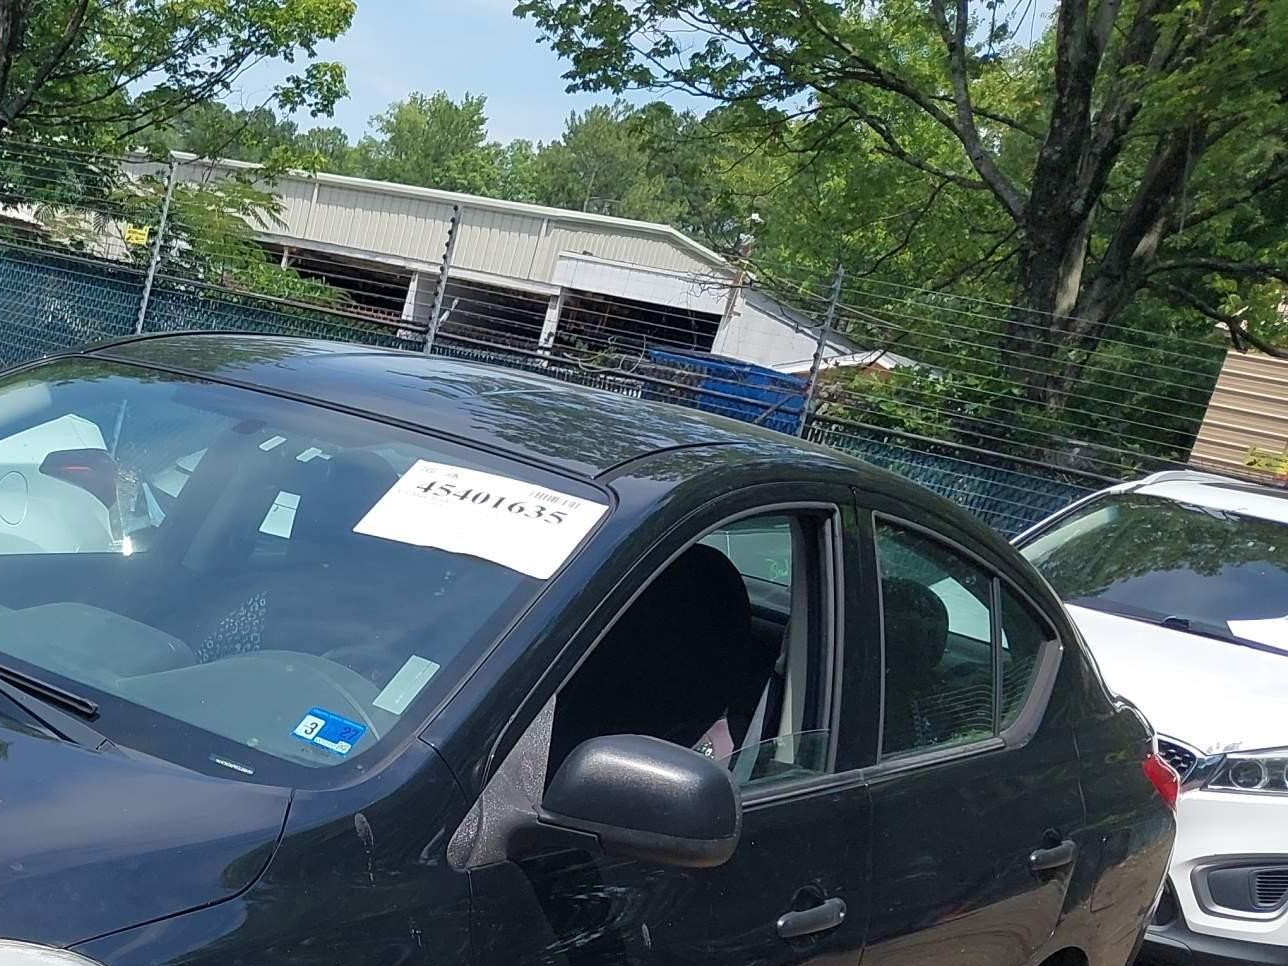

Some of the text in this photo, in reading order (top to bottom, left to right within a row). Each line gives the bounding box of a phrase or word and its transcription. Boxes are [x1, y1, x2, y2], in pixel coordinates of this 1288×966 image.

[415, 480, 569, 526] 45401635
[304, 721, 319, 736] 3
[339, 726, 360, 741] 27
